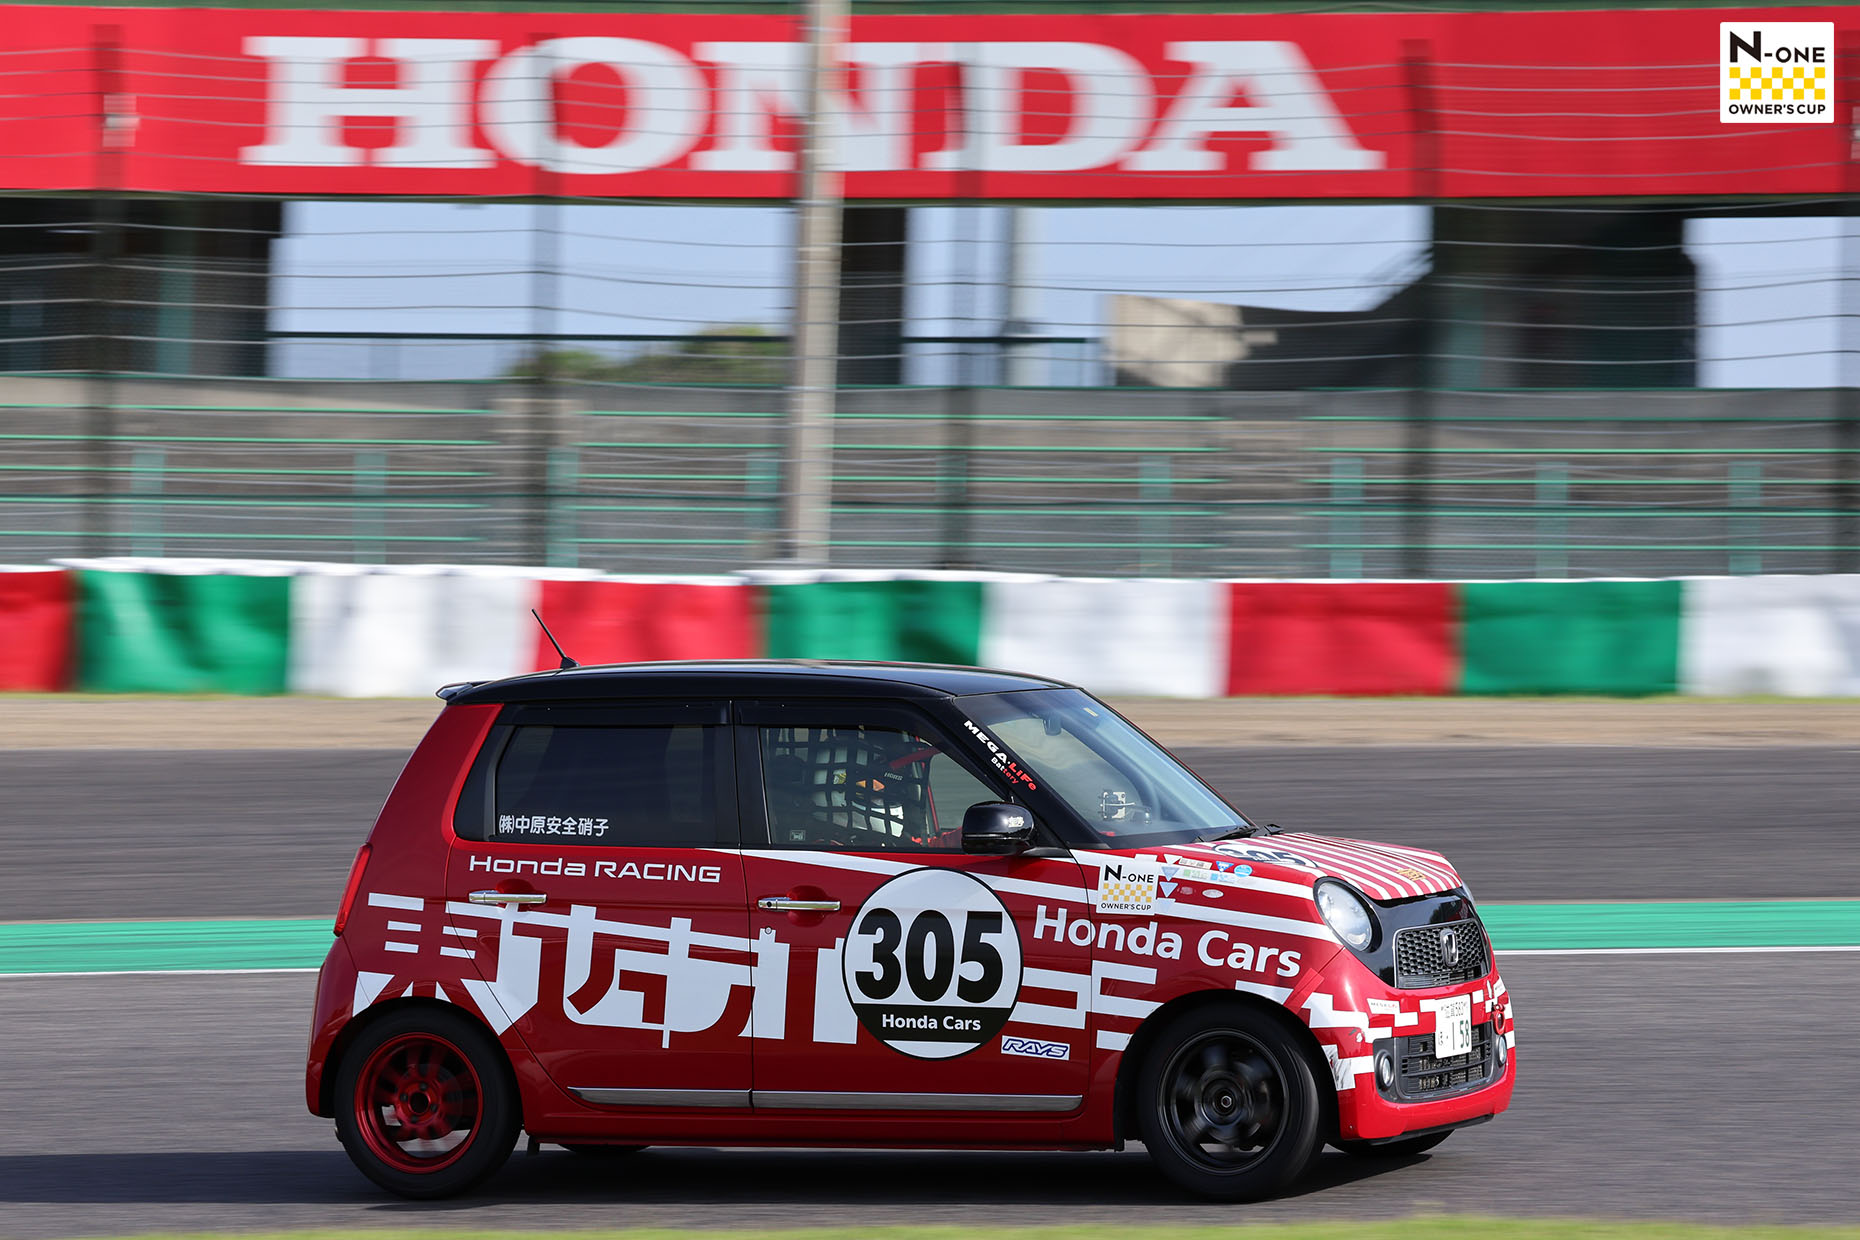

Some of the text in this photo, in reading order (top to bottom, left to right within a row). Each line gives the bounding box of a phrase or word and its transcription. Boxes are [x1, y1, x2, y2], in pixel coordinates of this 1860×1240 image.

[240, 36, 1386, 175] HONDA
[469, 855, 721, 883] Honda RACING
[1104, 864, 1154, 883] N-ONE
[1101, 902, 1135, 910] OWNER'S
[1033, 904, 1301, 978] Honda Cars
[855, 907, 1003, 1003] 305
[882, 1014, 981, 1031] Honda Cars
[1003, 1038, 1068, 1058] RAYS
